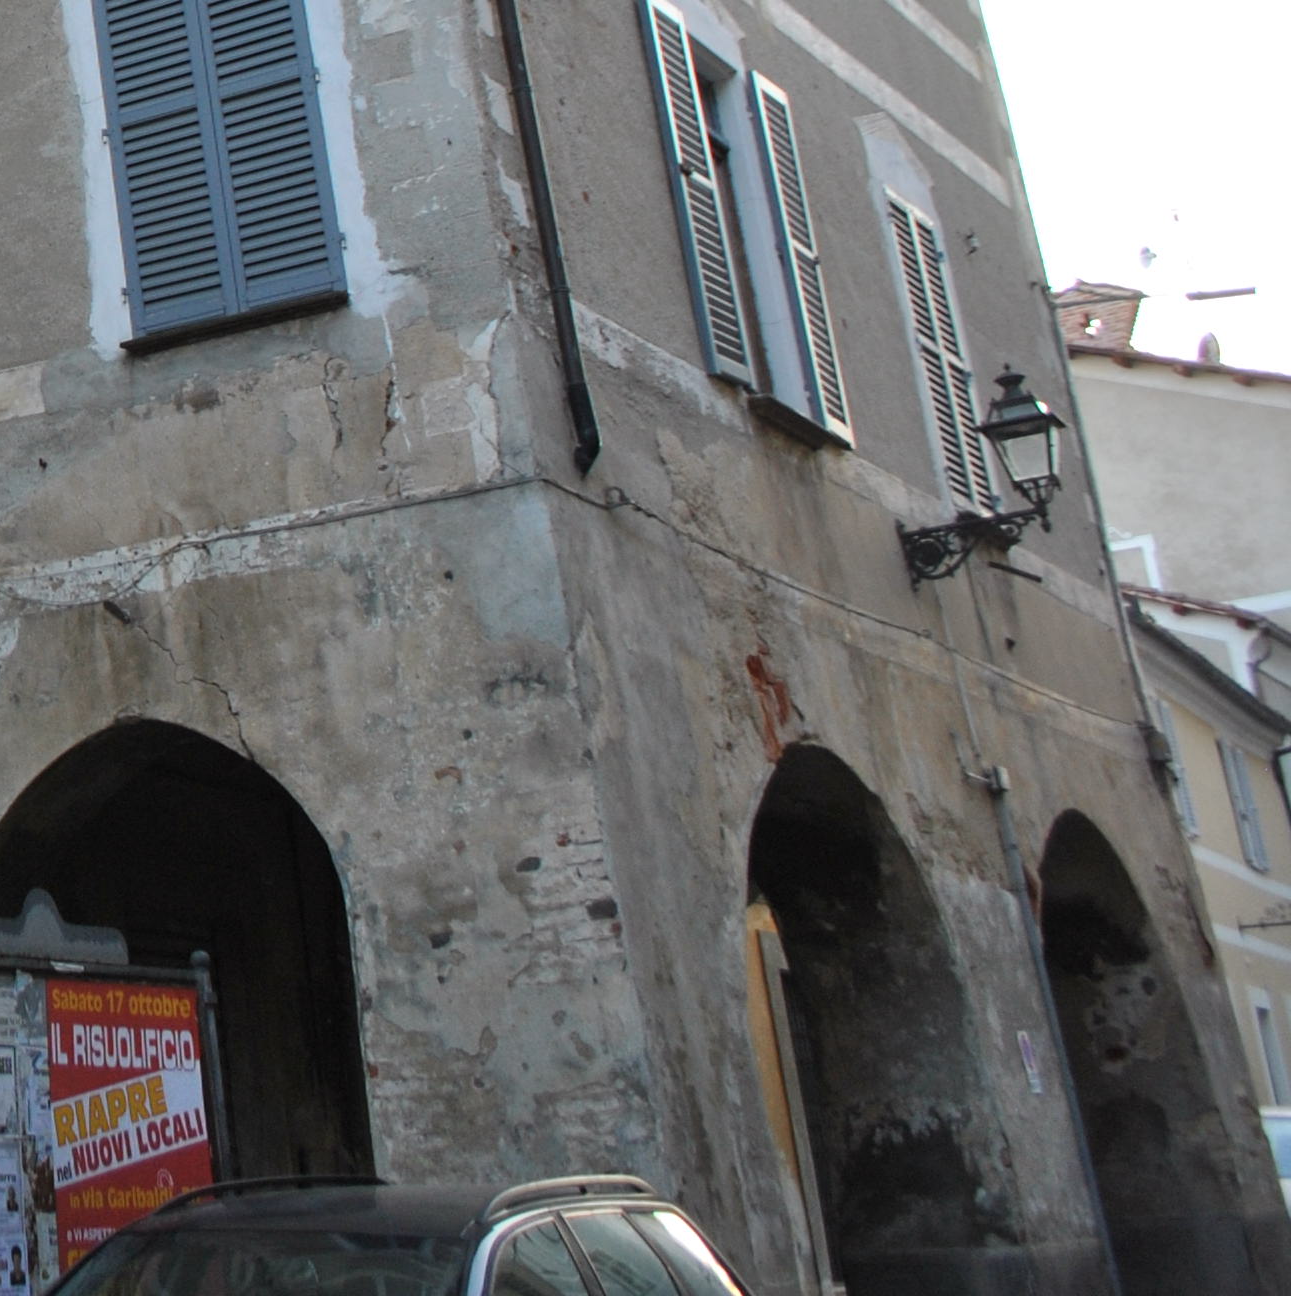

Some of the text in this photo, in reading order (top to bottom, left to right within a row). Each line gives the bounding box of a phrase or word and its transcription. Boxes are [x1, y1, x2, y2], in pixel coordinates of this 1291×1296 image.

[52, 988, 191, 1019] Sabato 17 ottobre
[50, 1022, 68, 1066] IL
[72, 1024, 195, 1071] RISUOLIFICIO
[53, 1075, 167, 1148] RIAPRE
[57, 1107, 204, 1183] nei NUOVI LOCALI
[82, 1187, 104, 1210] via
